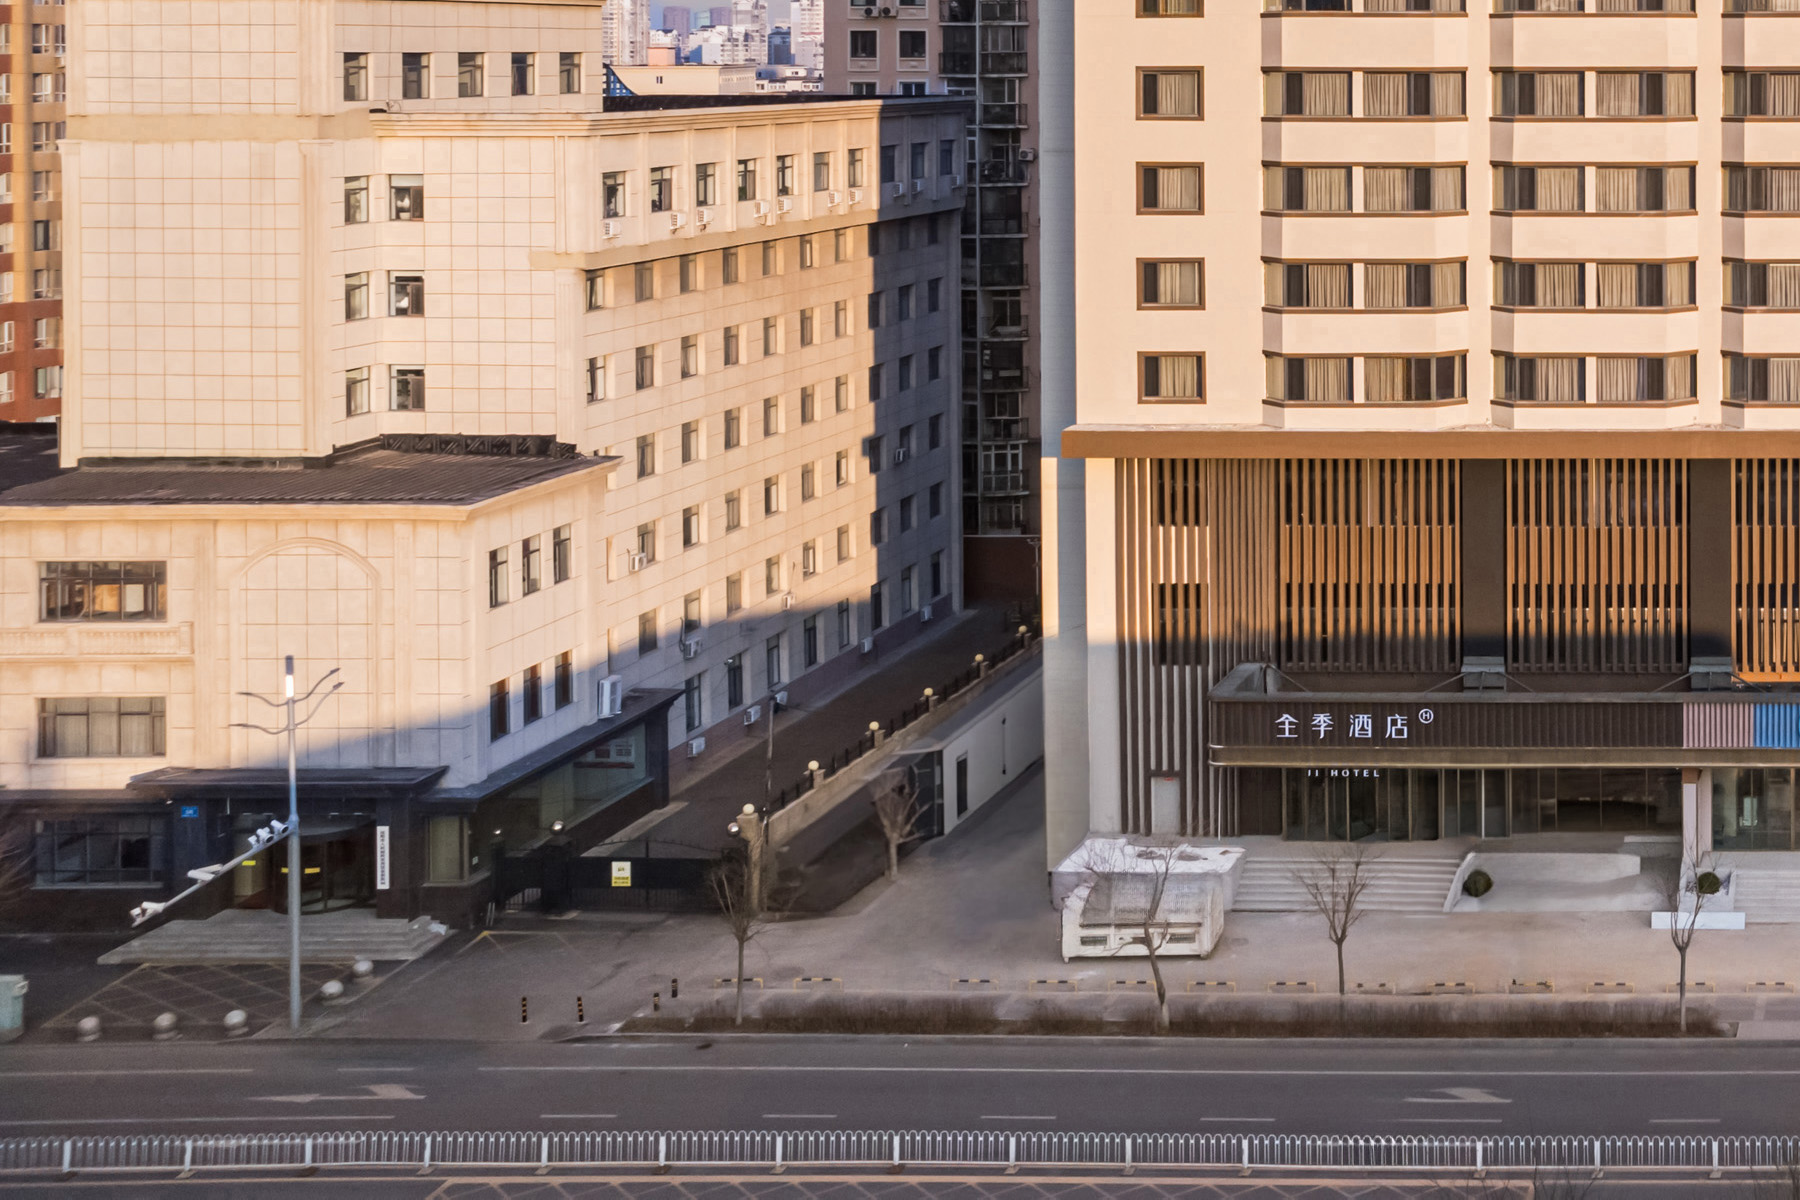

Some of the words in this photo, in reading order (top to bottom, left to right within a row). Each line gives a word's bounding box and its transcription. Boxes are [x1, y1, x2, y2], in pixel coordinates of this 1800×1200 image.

[1275, 713, 1408, 739] 全季酒店
[1330, 769, 1380, 777] HOTEL
